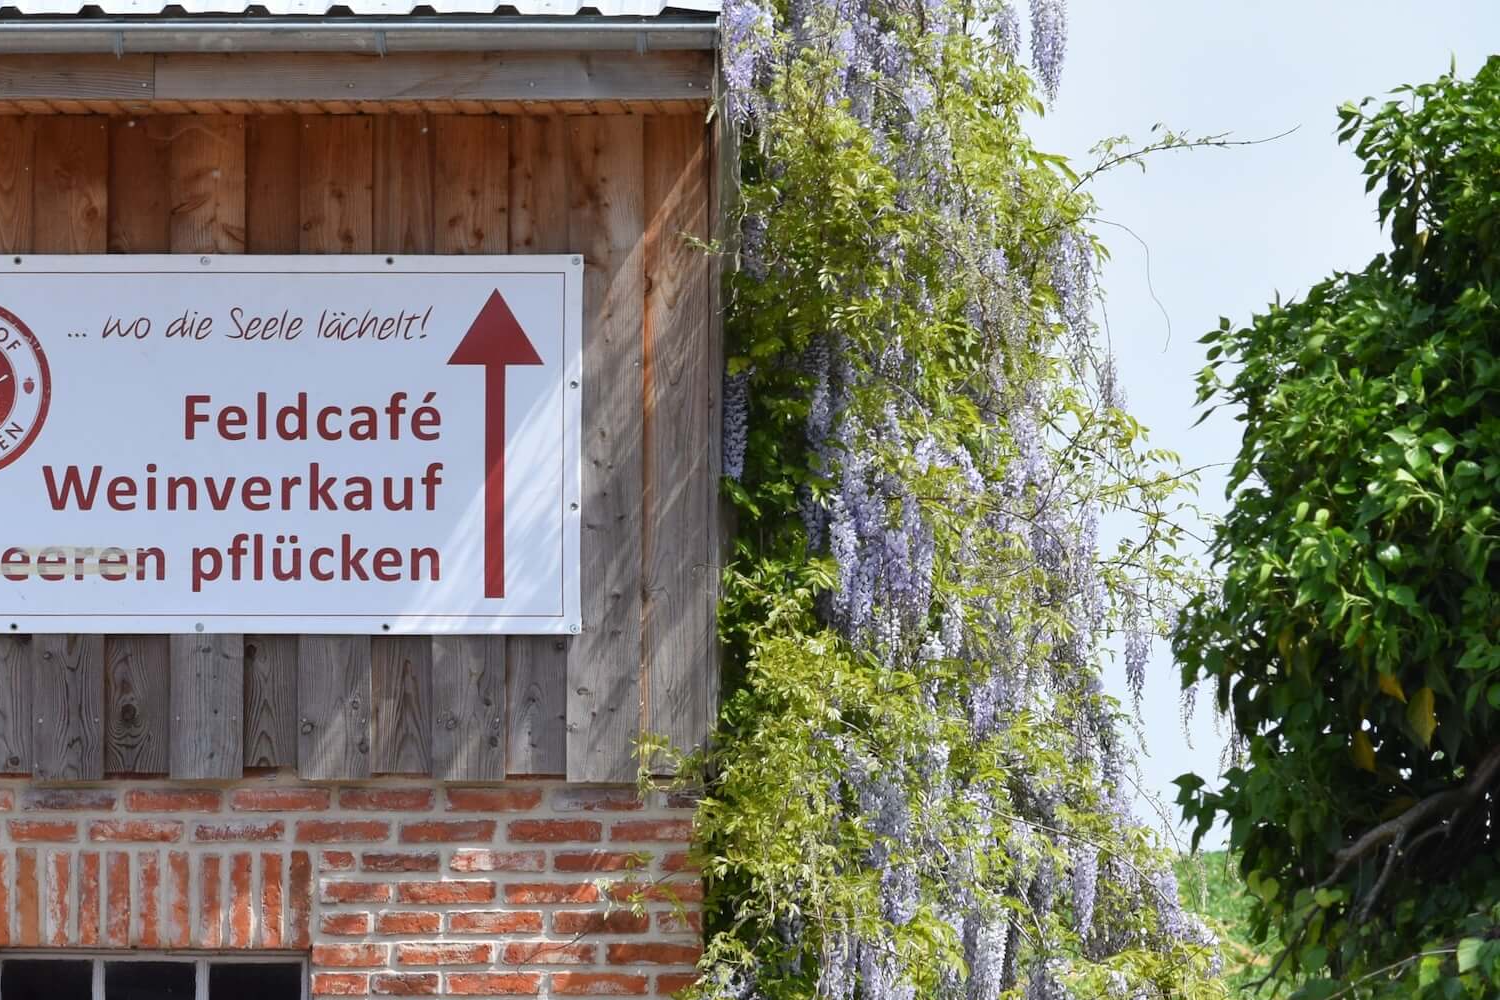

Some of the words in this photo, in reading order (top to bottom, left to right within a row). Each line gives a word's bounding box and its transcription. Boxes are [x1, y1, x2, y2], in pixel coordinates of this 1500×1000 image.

[101, 315, 152, 341] wo
[165, 309, 214, 342] die
[224, 306, 304, 342] Seele
[316, 305, 434, 343] lächelt!
[184, 391, 442, 442] Feldcafé
[42, 462, 444, 512] Weinverkauf
[191, 533, 441, 593] pflücken
